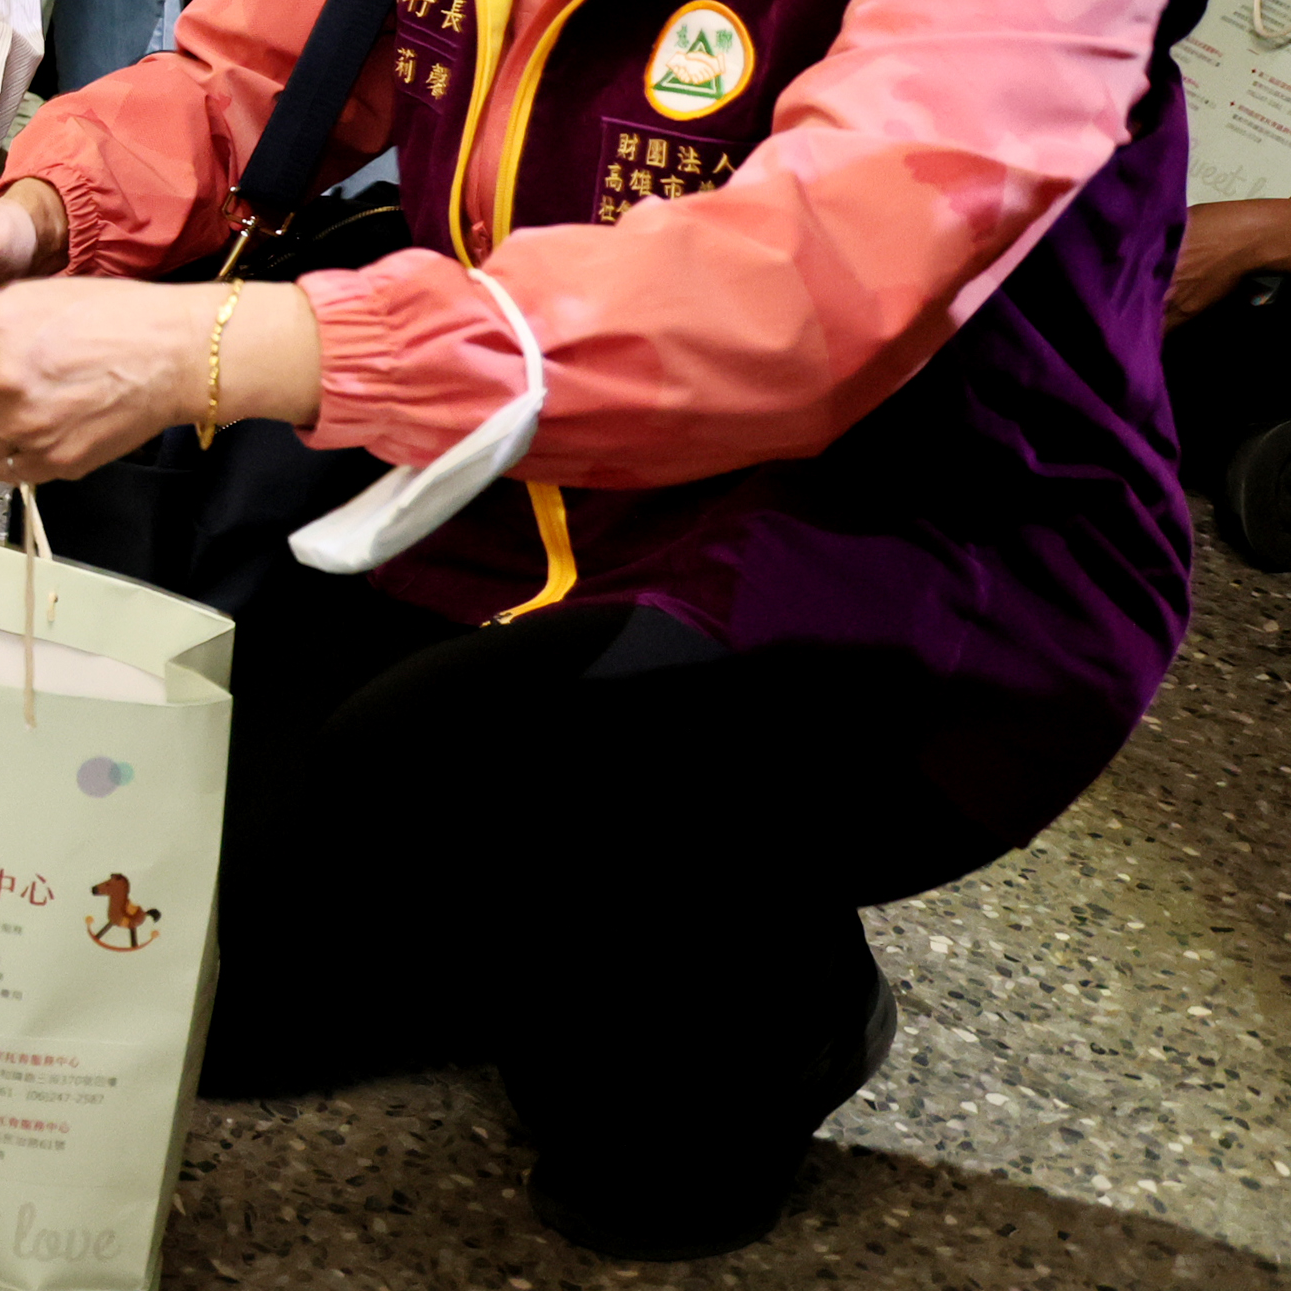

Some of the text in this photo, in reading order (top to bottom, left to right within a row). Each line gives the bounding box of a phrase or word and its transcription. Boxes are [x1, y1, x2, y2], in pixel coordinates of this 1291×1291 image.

[617, 133, 737, 175] 財團法人
[12, 1201, 120, 1264] love
